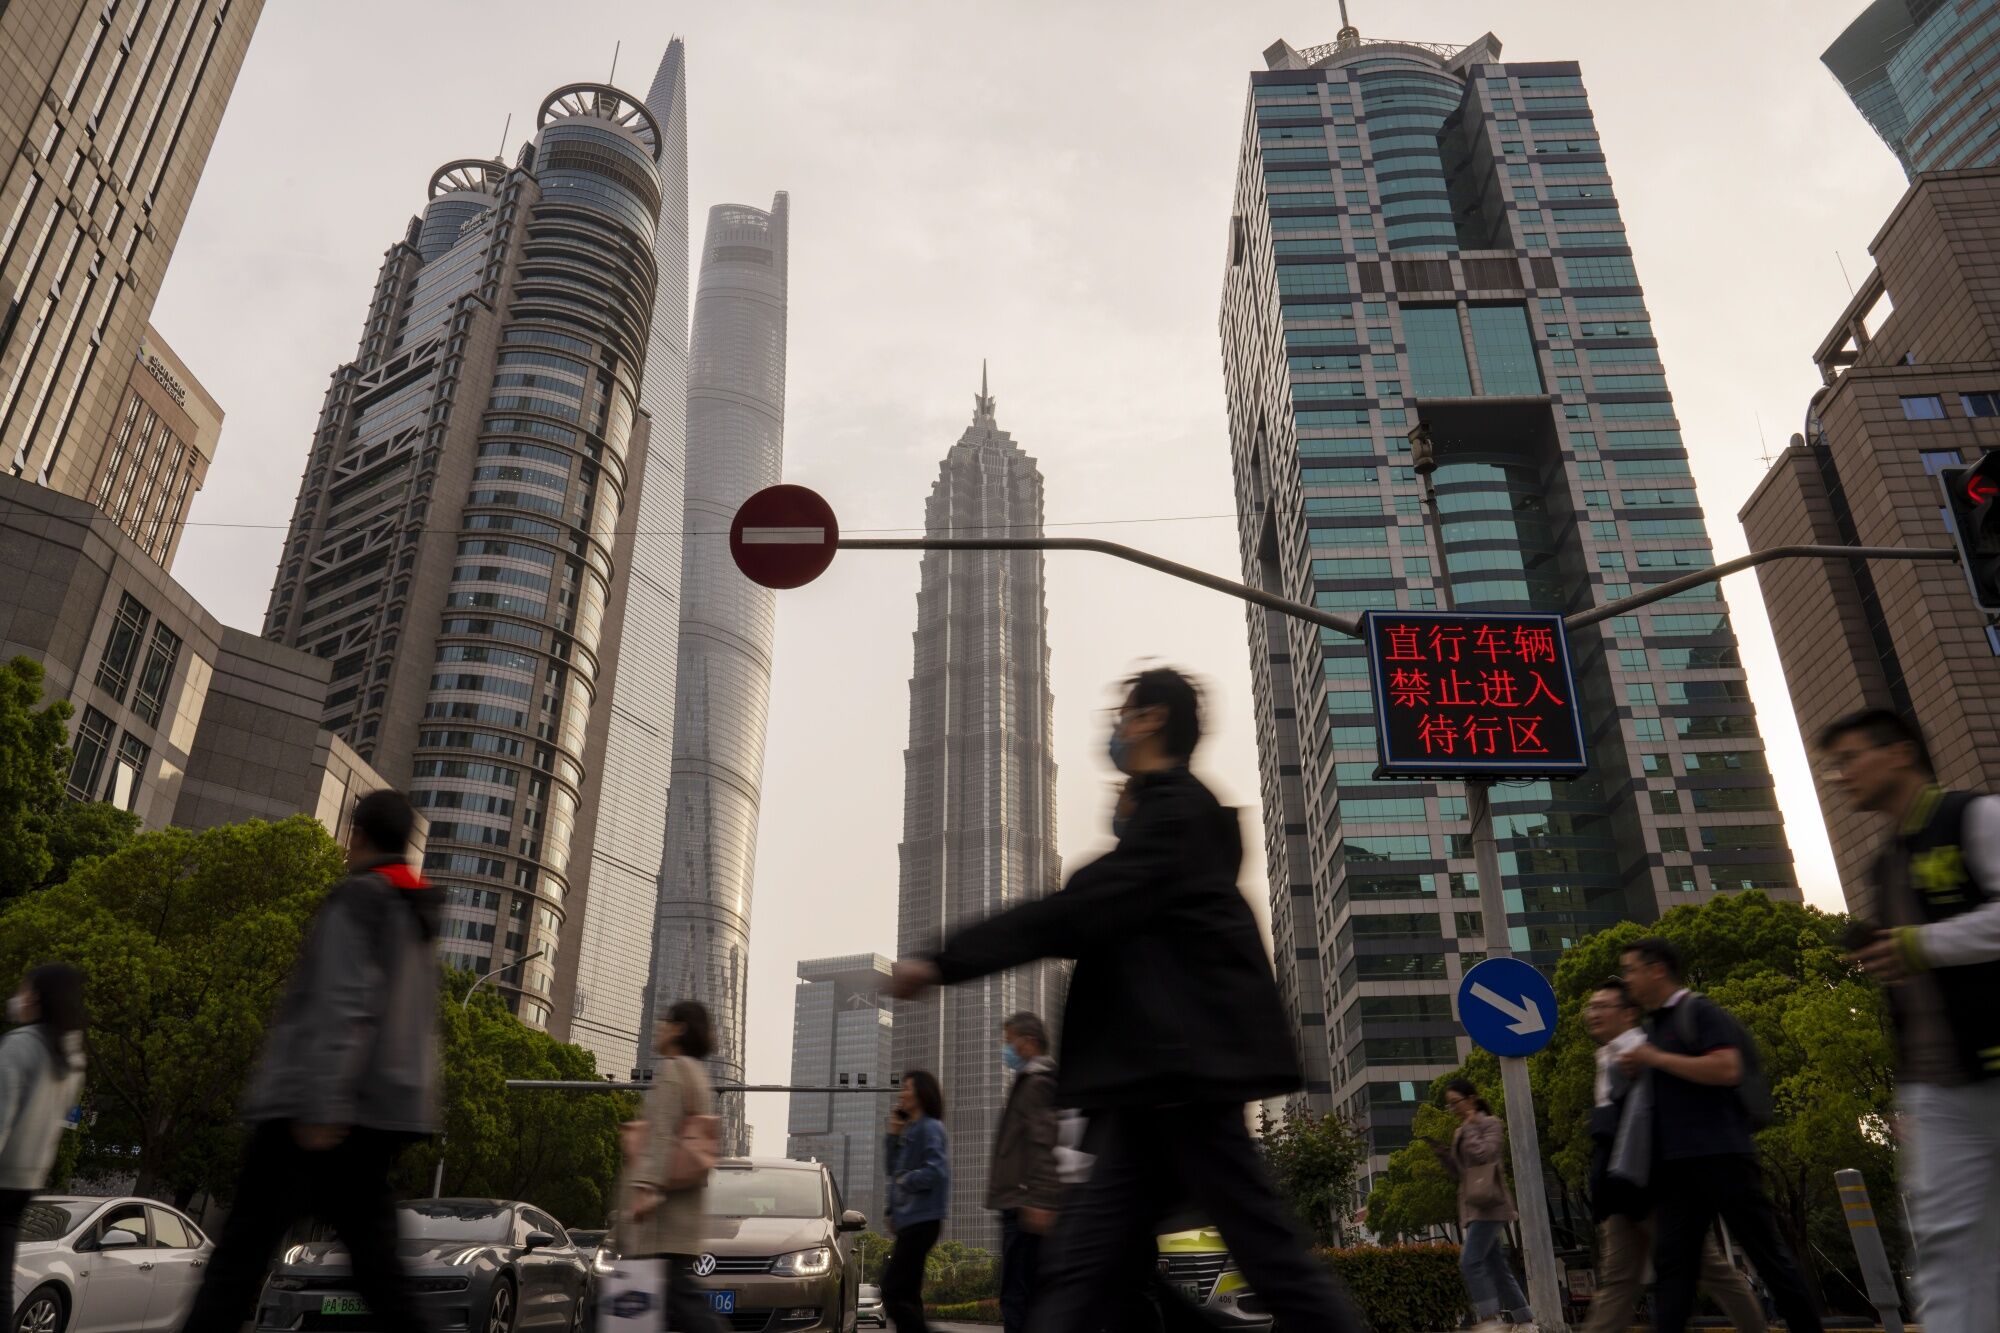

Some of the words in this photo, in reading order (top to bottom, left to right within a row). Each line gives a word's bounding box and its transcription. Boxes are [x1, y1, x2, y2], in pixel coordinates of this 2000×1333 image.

[1384, 623, 1556, 664] 直行车辆
[1389, 667, 1566, 709] 禁止进入
[1417, 713, 1550, 755] 待行区
